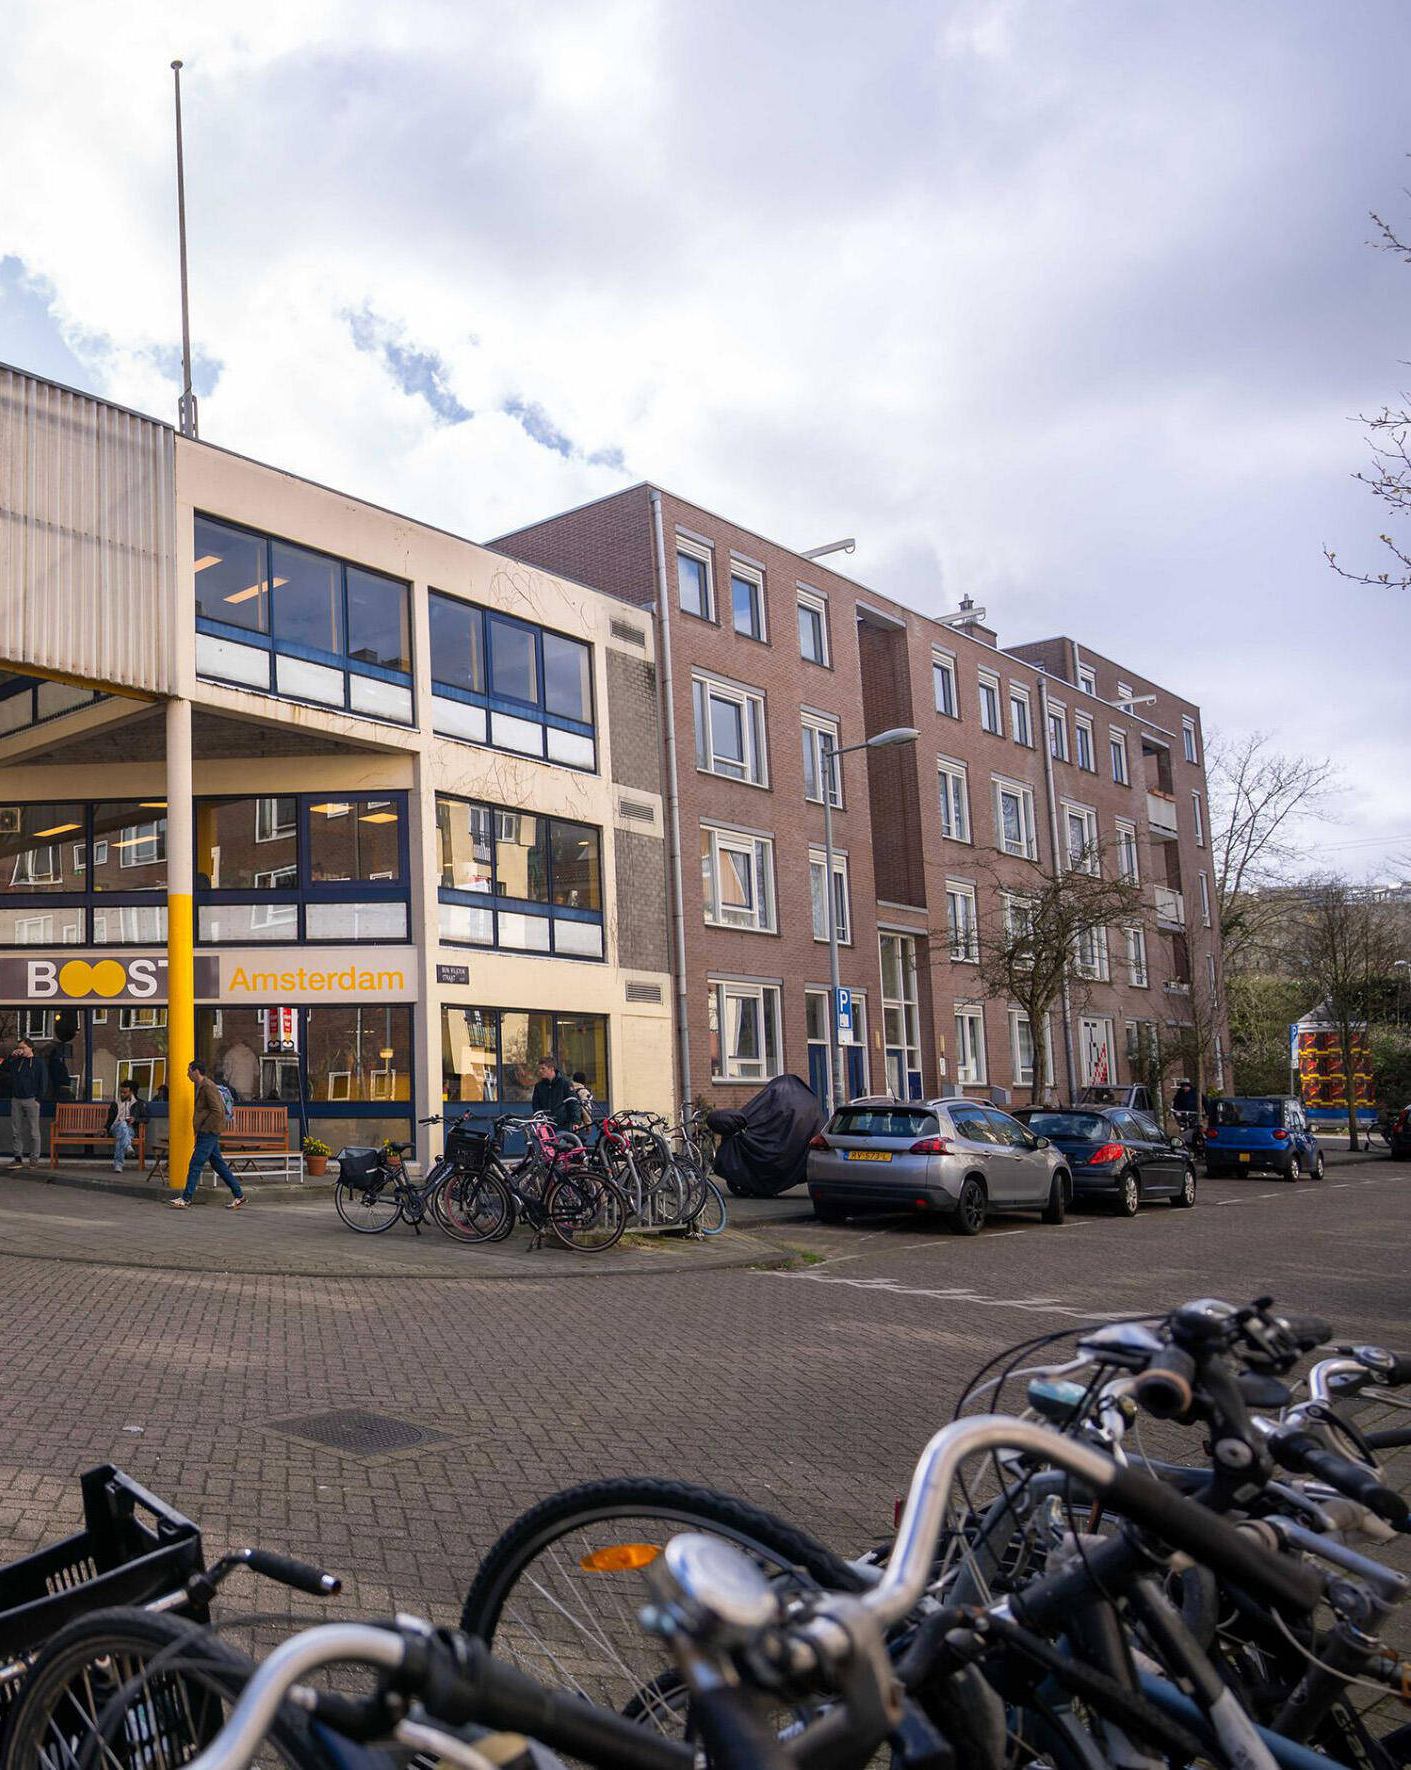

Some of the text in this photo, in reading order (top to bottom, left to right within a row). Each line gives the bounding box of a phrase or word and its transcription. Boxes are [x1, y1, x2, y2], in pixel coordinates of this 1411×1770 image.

[27, 959, 168, 998] BOOS
[228, 965, 404, 991] Amsterdam
[839, 990, 848, 1013] P
